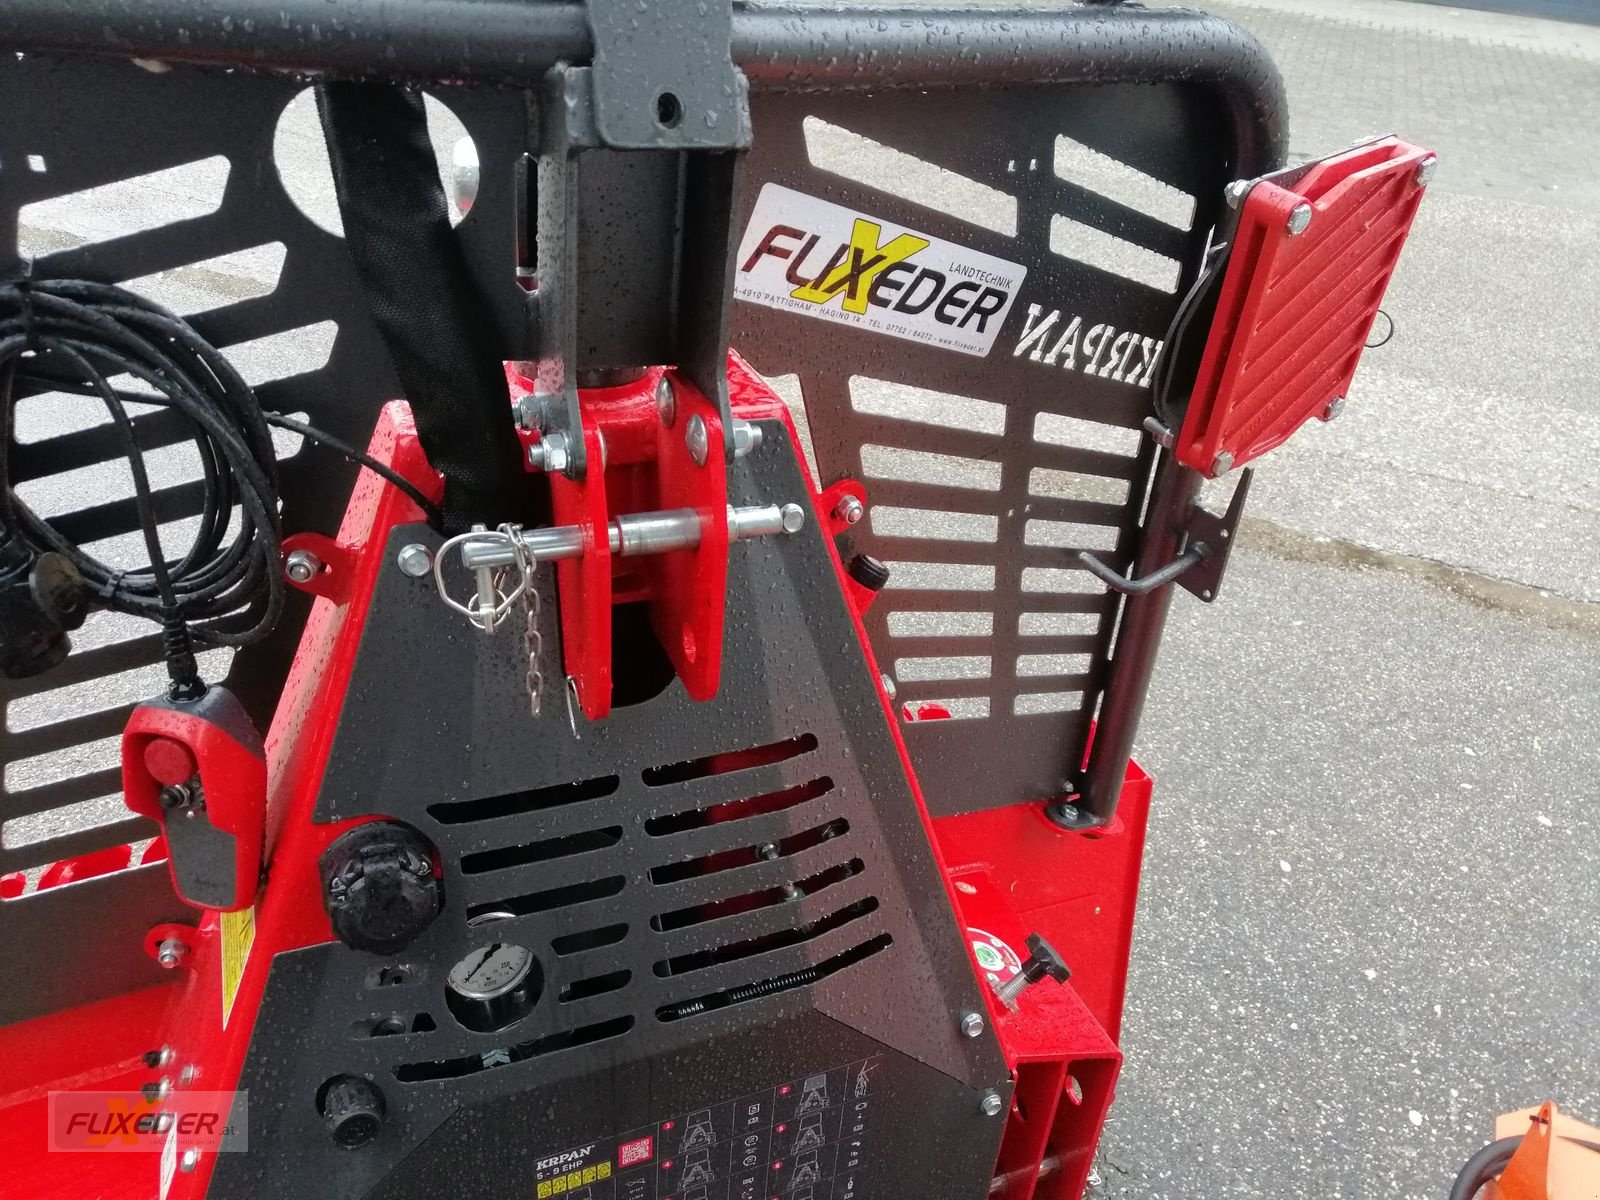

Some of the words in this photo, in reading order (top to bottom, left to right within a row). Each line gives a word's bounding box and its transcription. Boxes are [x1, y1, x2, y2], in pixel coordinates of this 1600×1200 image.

[741, 223, 1009, 334] FLIXEDER
[948, 261, 1014, 289] LANDTECHNIK
[764, 293, 812, 312] PATTIGHAM
[820, 307, 849, 321] HAGING
[536, 1146, 593, 1171] KRPAN
[562, 1160, 583, 1172] EHP
